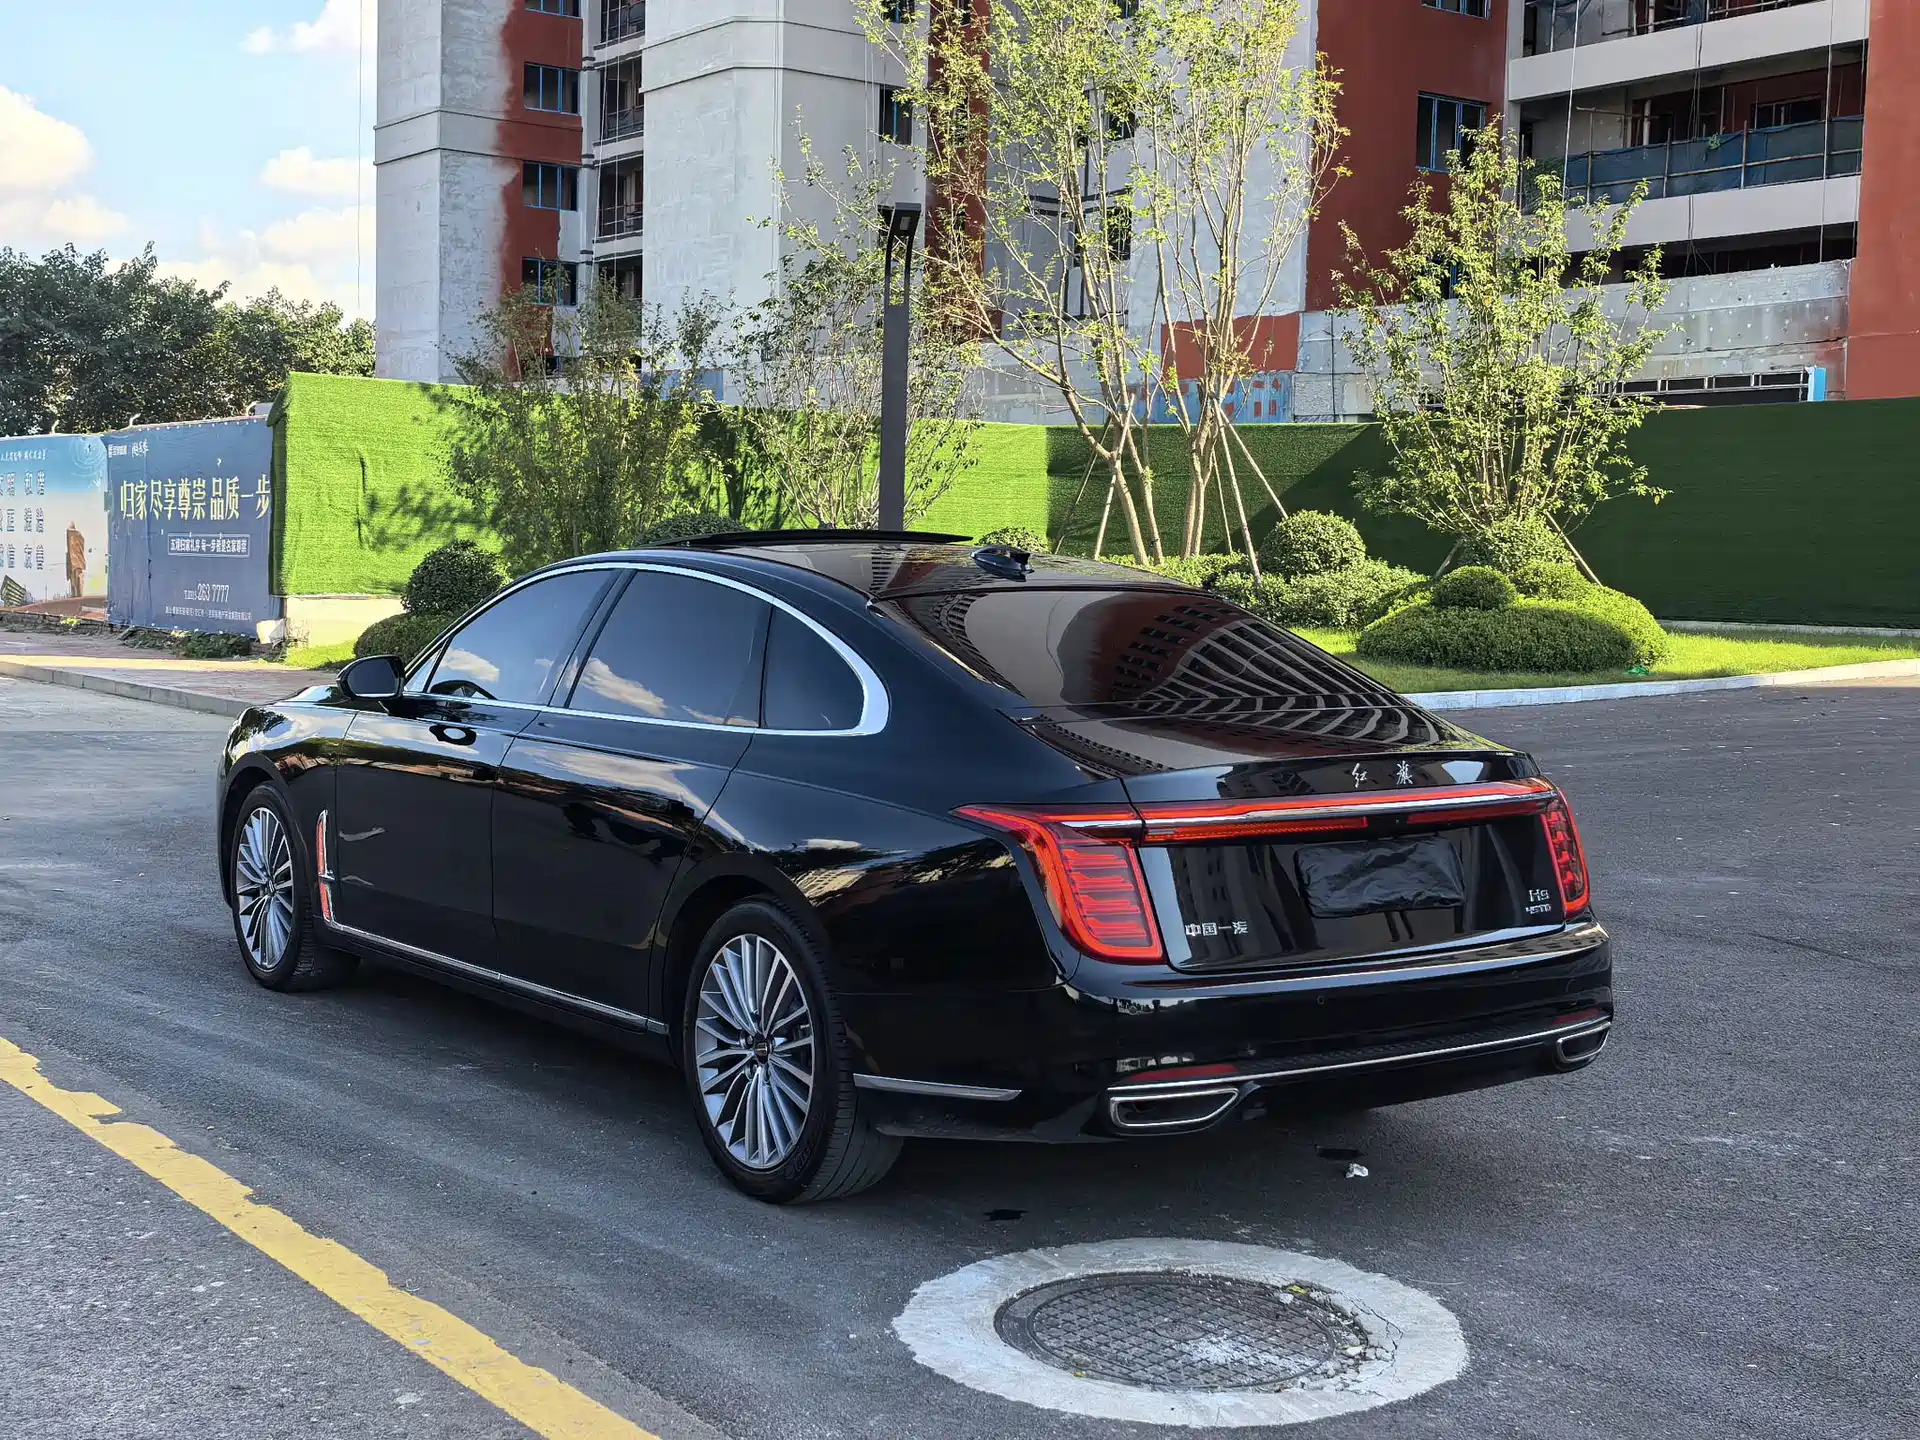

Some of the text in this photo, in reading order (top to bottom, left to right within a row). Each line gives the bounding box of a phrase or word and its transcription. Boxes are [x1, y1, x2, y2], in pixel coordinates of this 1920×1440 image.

[120, 474, 271, 520] 归家尽享尊崇 品质一步
[212, 584, 229, 603] 7777
[1352, 760, 1413, 788] 红旗
[1185, 921, 1248, 936] 中国一汽
